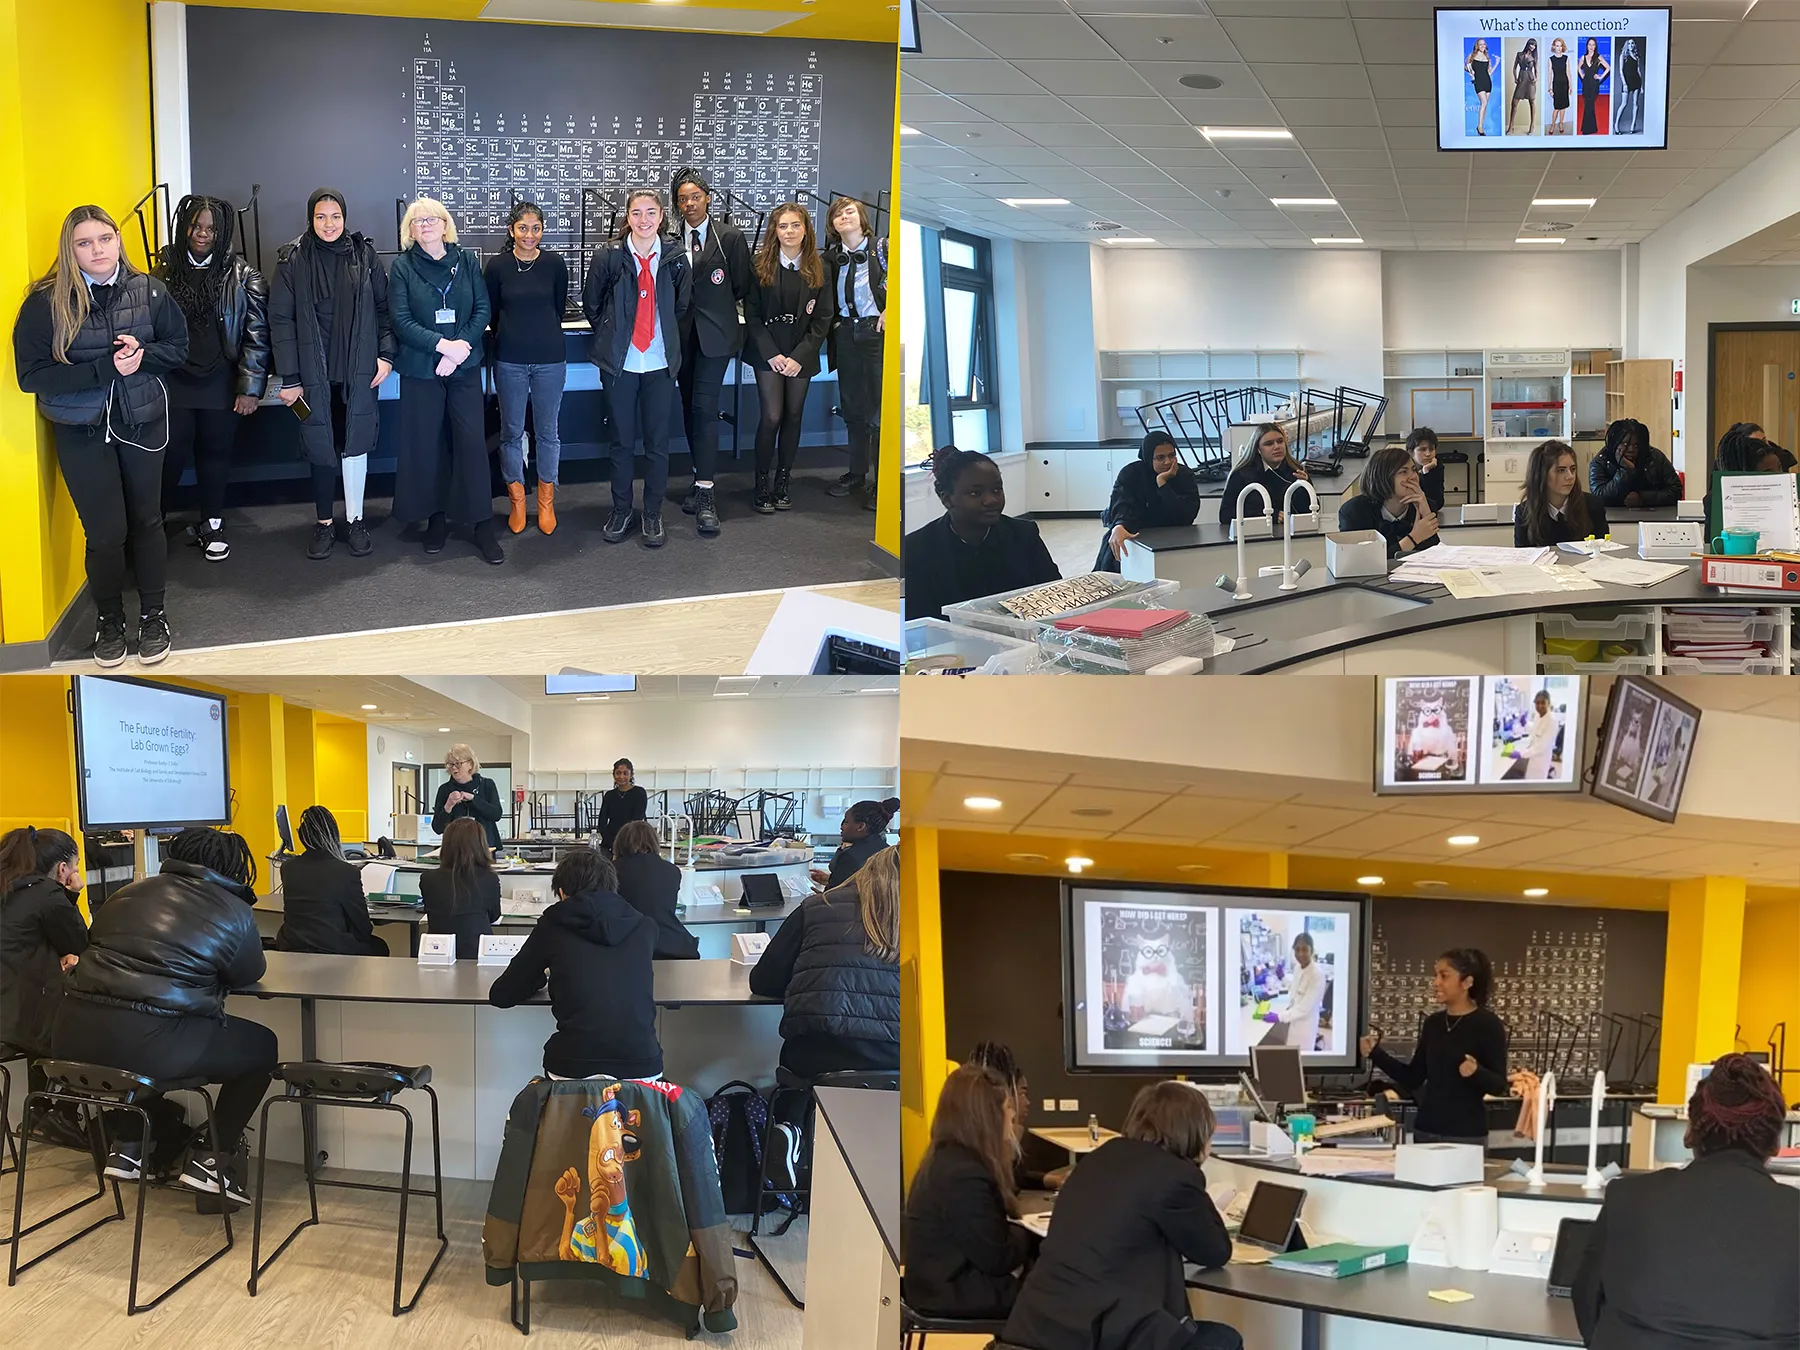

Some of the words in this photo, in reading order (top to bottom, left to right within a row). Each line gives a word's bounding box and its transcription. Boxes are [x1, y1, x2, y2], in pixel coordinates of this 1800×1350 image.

[1480, 18, 1524, 31] What's
[1528, 18, 1548, 31] the
[1551, 18, 1629, 31] connection?
[416, 66, 423, 74] H
[802, 80, 813, 88] He
[417, 91, 424, 100] Li
[442, 92, 453, 101] Be
[695, 100, 701, 108] B
[716, 101, 722, 109] C
[759, 102, 766, 110] O
[801, 103, 812, 111] Ne
[441, 117, 455, 128] Mg
[715, 124, 724, 132] Si
[737, 124, 743, 132] P
[779, 125, 787, 133] Cl
[417, 142, 424, 150] K
[442, 143, 453, 151] Ca
[465, 143, 477, 152] Sc
[490, 144, 498, 152] Ti
[512, 144, 519, 152] V
[536, 144, 547, 153] Cr
[560, 145, 573, 153] Mn
[582, 145, 593, 154] Fe
[605, 146, 616, 154] Co
[628, 146, 636, 154] Ni
[736, 148, 746, 156] As
[778, 148, 788, 156] Br
[417, 167, 430, 175] Rb
[441, 167, 452, 175] Sr
[465, 167, 472, 176] Y
[490, 168, 500, 176] Zr
[514, 168, 526, 177] Nb
[537, 168, 550, 177] Mo
[559, 169, 569, 177] Tc
[582, 169, 593, 177] Ru
[604, 169, 616, 178] Rh
[649, 170, 660, 180] Ag
[418, 191, 429, 199] Cs
[442, 192, 454, 200] Ba
[466, 192, 477, 200] Lu
[490, 192, 501, 200] Hf
[536, 192, 544, 200] W
[559, 192, 570, 201] Re
[604, 193, 611, 201] Ir
[755, 193, 767, 201] Po
[798, 193, 808, 201] Rn
[466, 216, 476, 224] Lr
[490, 216, 500, 224] Rf
[559, 218, 570, 226] Bh
[734, 218, 751, 227] Uup
[119, 720, 134, 733] The
[136, 723, 160, 736] Future
[161, 726, 169, 736] of
[170, 727, 197, 741] Fertility:
[130, 739, 144, 750] Lab
[145, 740, 169, 752] Grown
[171, 743, 189, 756] Eggs?
